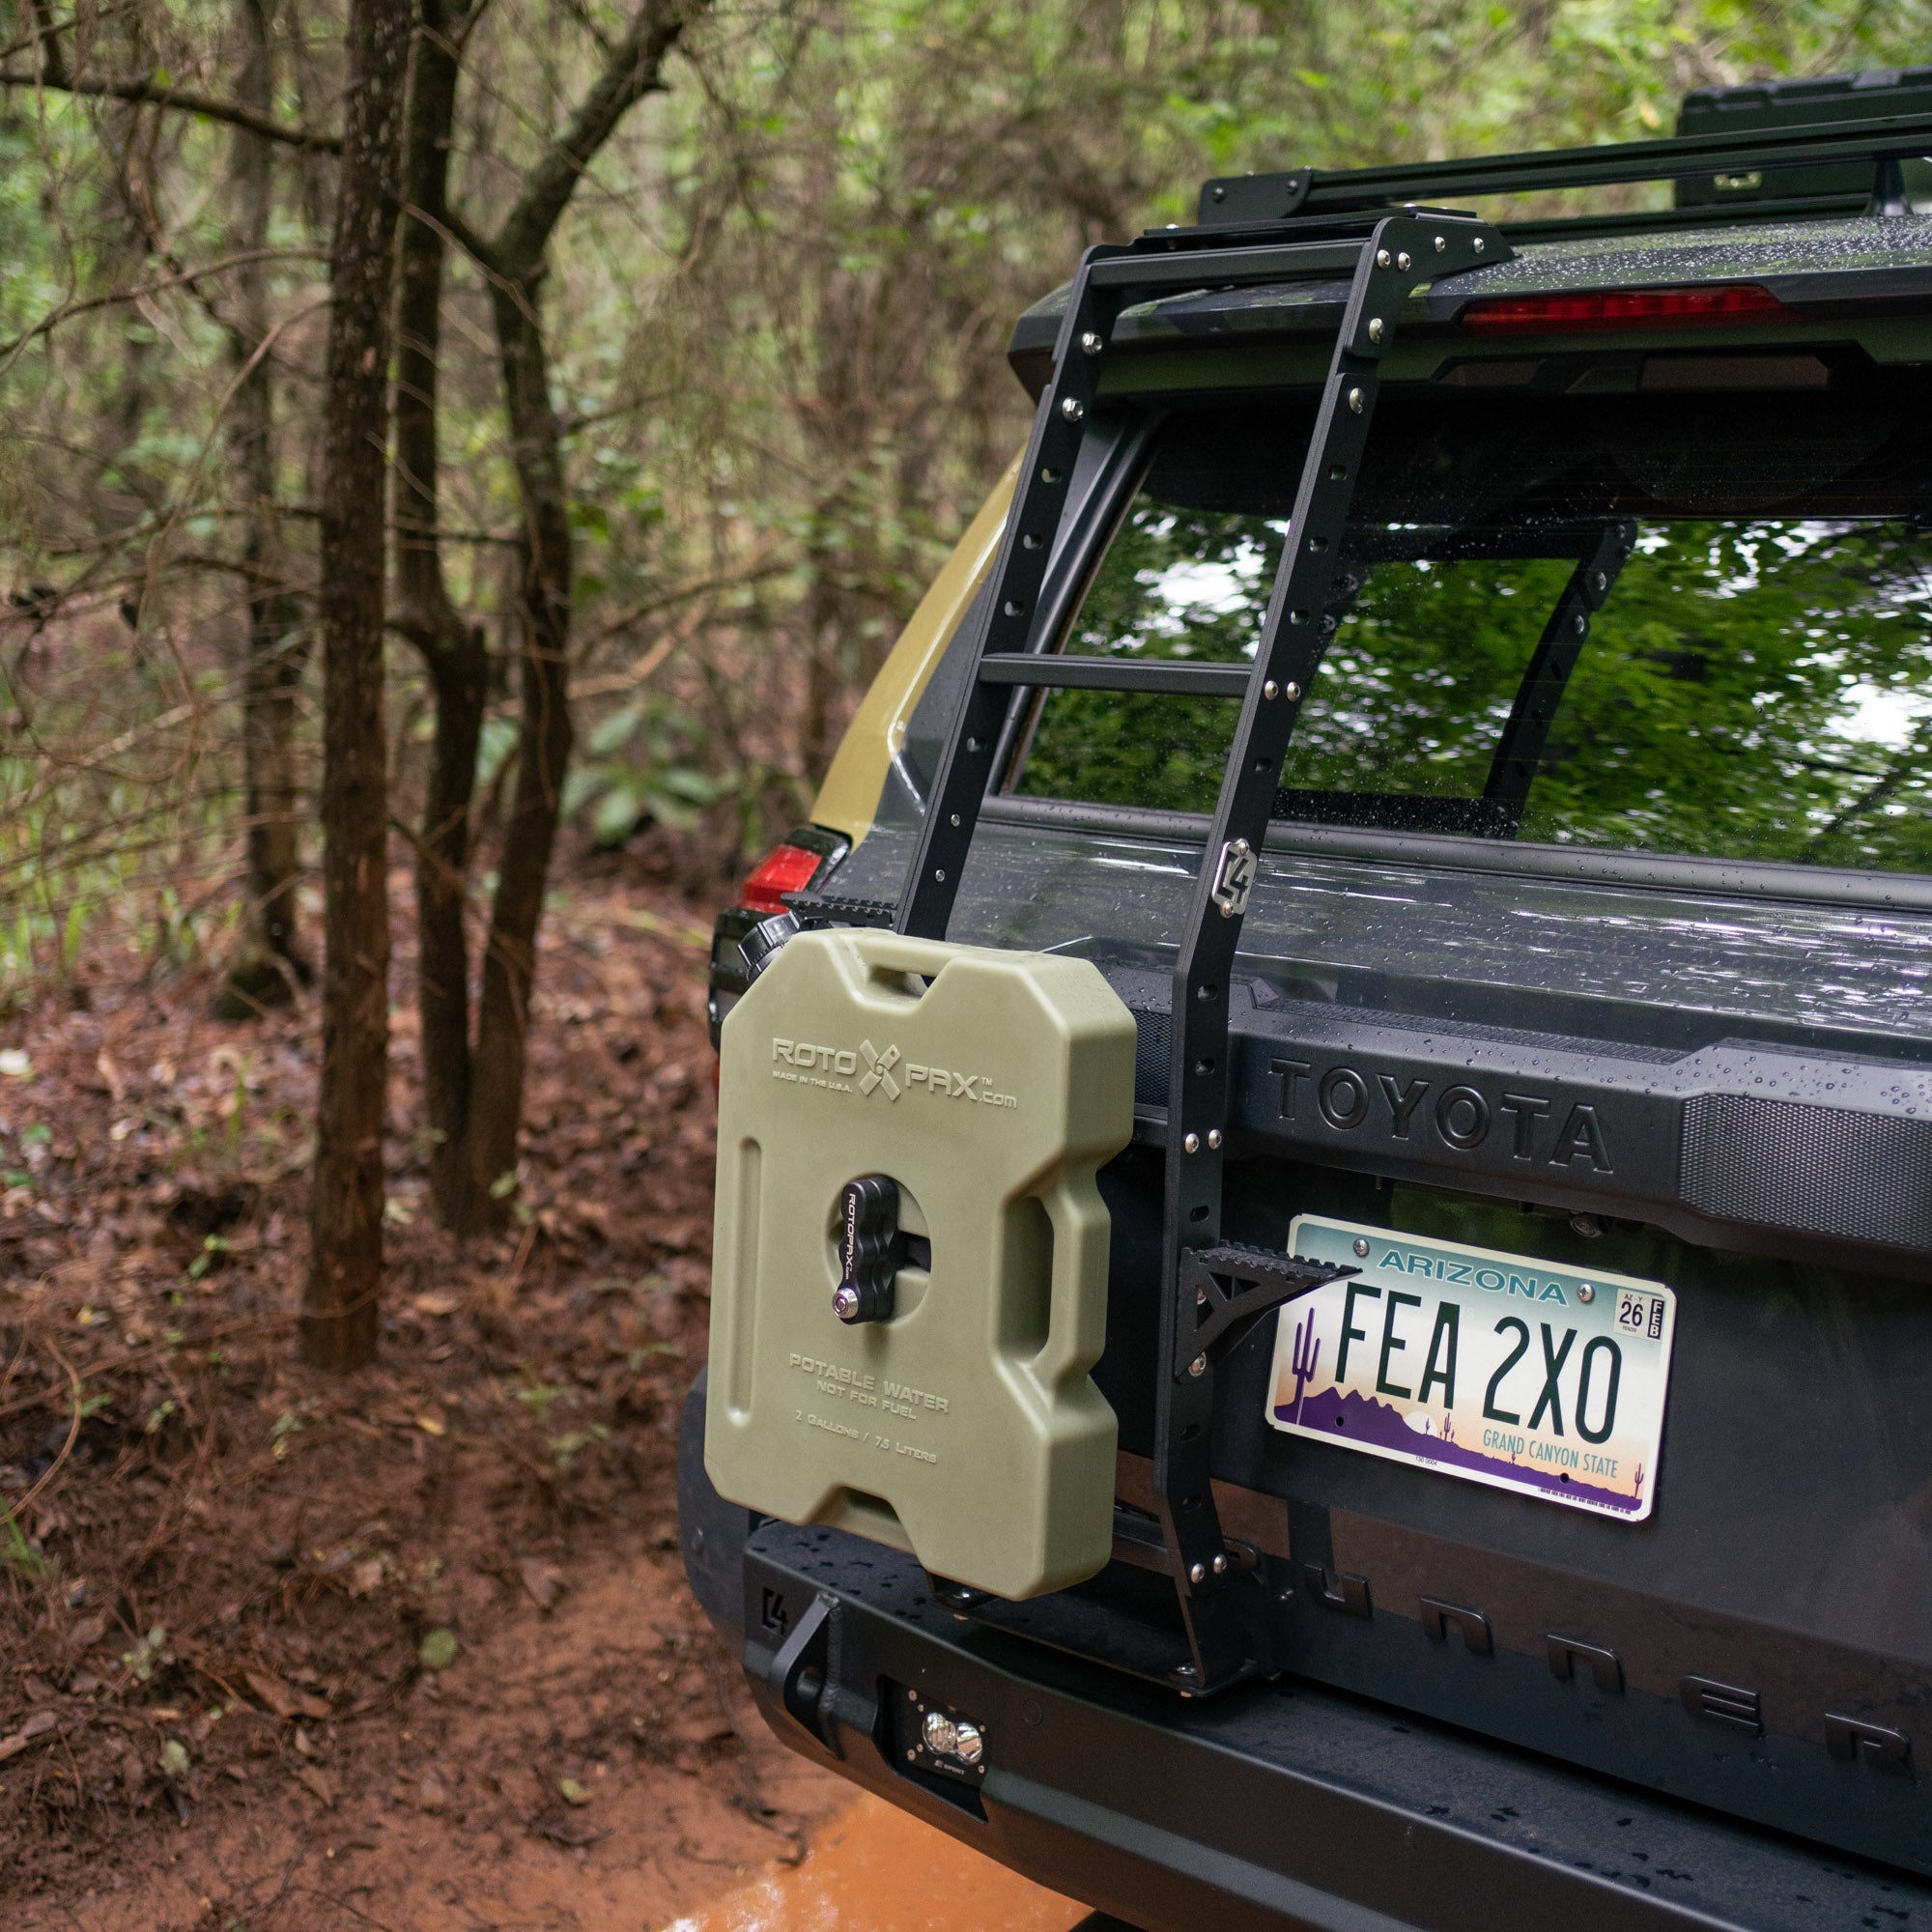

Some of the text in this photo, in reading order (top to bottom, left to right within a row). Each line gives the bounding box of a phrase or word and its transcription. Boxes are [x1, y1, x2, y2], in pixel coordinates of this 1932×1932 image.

[773, 1037, 857, 1074] ROTO
[773, 1070, 798, 1082] MADE
[799, 1075, 809, 1084] IN
[810, 1078, 827, 1088] THE
[1267, 1057, 1614, 1175] TOYOTA
[1377, 1249, 1570, 1308] ARIZONA
[1619, 1300, 1643, 1326] 26
[1650, 1300, 1662, 1337] FEB
[1334, 1281, 1461, 1410] FEA
[789, 1352, 950, 1413] POTABLE WATER
[817, 1379, 917, 1420] NOT FOR FUEL
[795, 1409, 803, 1422] 2
[1483, 1429, 1619, 1478] GRAND CANYON STATE
